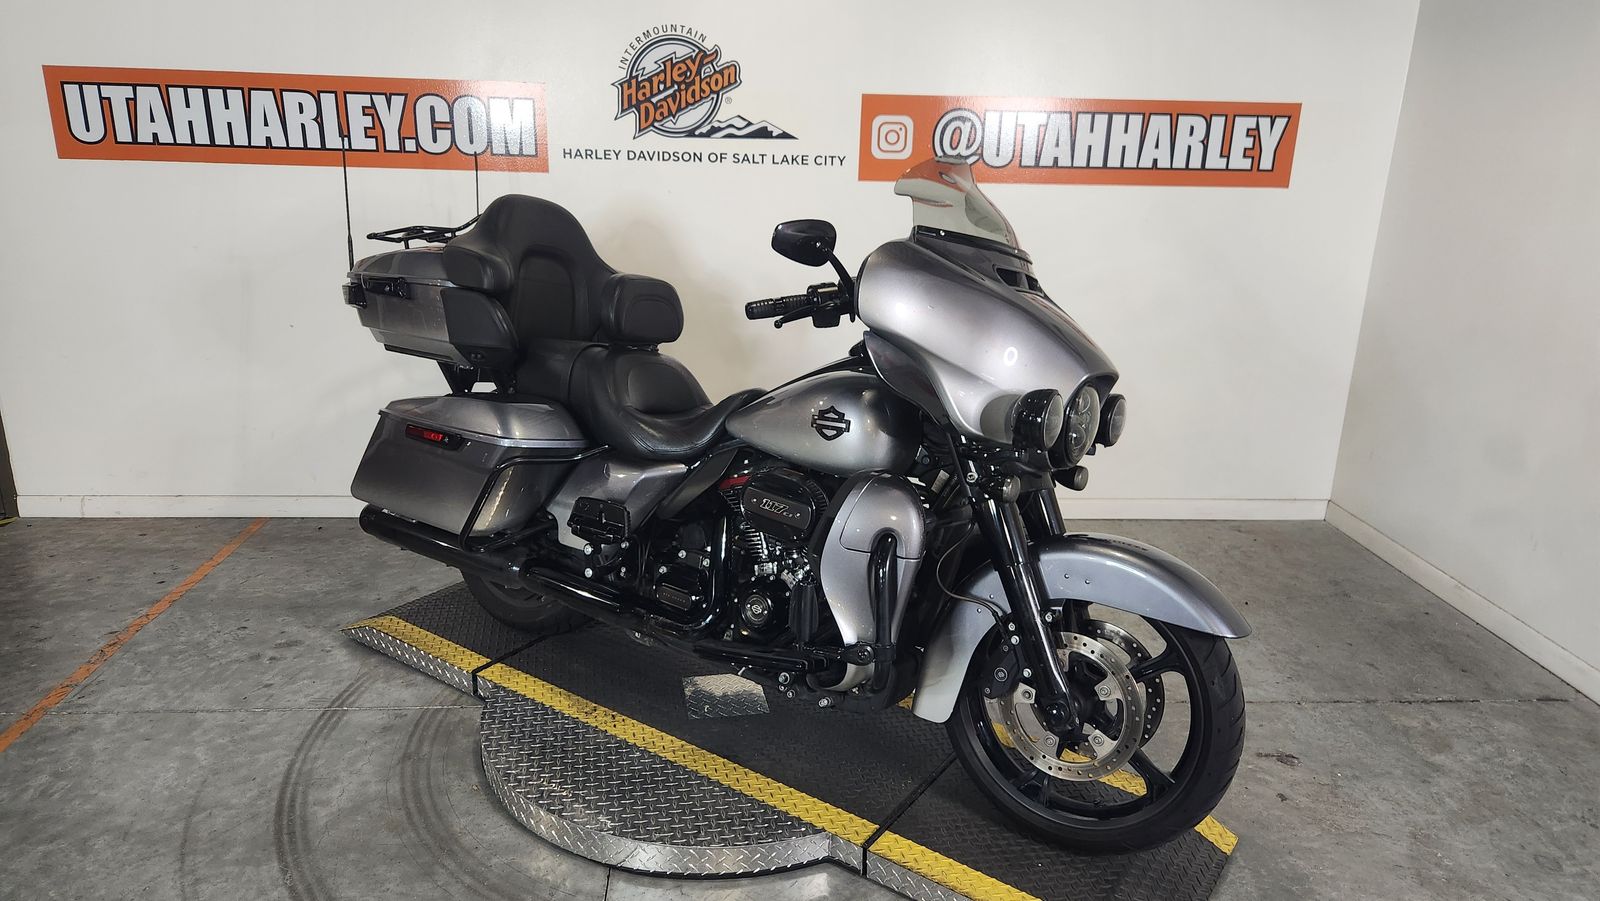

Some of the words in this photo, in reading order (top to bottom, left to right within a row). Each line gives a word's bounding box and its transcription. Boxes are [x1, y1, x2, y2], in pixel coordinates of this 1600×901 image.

[618, 23, 708, 70] INTERMOUNTAIN
[60, 81, 538, 158] UTAHHARLEY.COM
[638, 63, 738, 132] Davidson
[562, 148, 622, 161] HARLEY
[626, 149, 703, 164] DAVIDSON
[707, 152, 728, 164] OF
[732, 153, 768, 166] SALT
[771, 154, 809, 166] LAKE
[813, 155, 847, 167] CITY
[932, 107, 1292, 172] @UTAHHARLEY
[760, 498, 789, 513] 117
